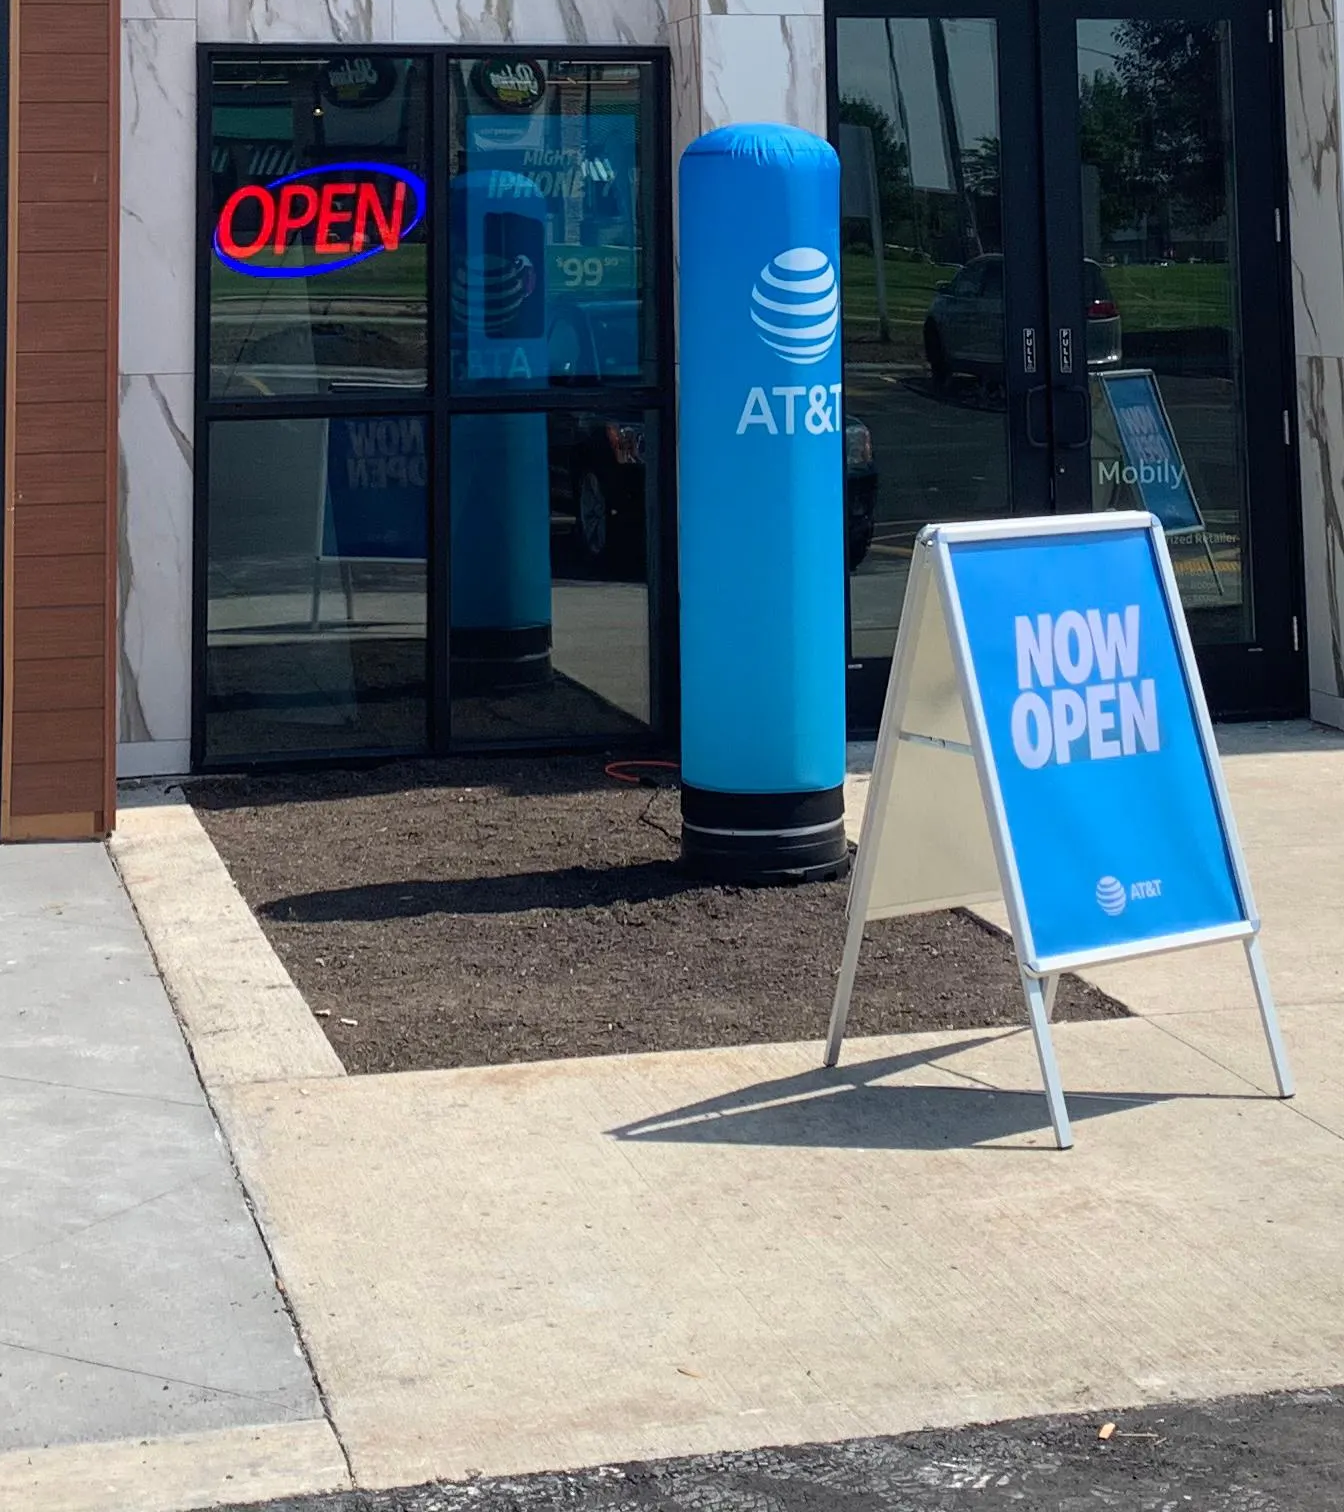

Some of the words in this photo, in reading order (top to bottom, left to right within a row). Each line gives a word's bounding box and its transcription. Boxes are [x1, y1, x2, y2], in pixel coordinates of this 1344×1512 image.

[523, 149, 587, 167] MIGHTY
[218, 182, 406, 258] OPEN
[736, 382, 842, 435] AT&T
[1098, 458, 1185, 490] Mobily
[1015, 605, 1141, 690] NOW
[1010, 680, 1160, 770] OPEN
[1131, 879, 1164, 900] AT&T
